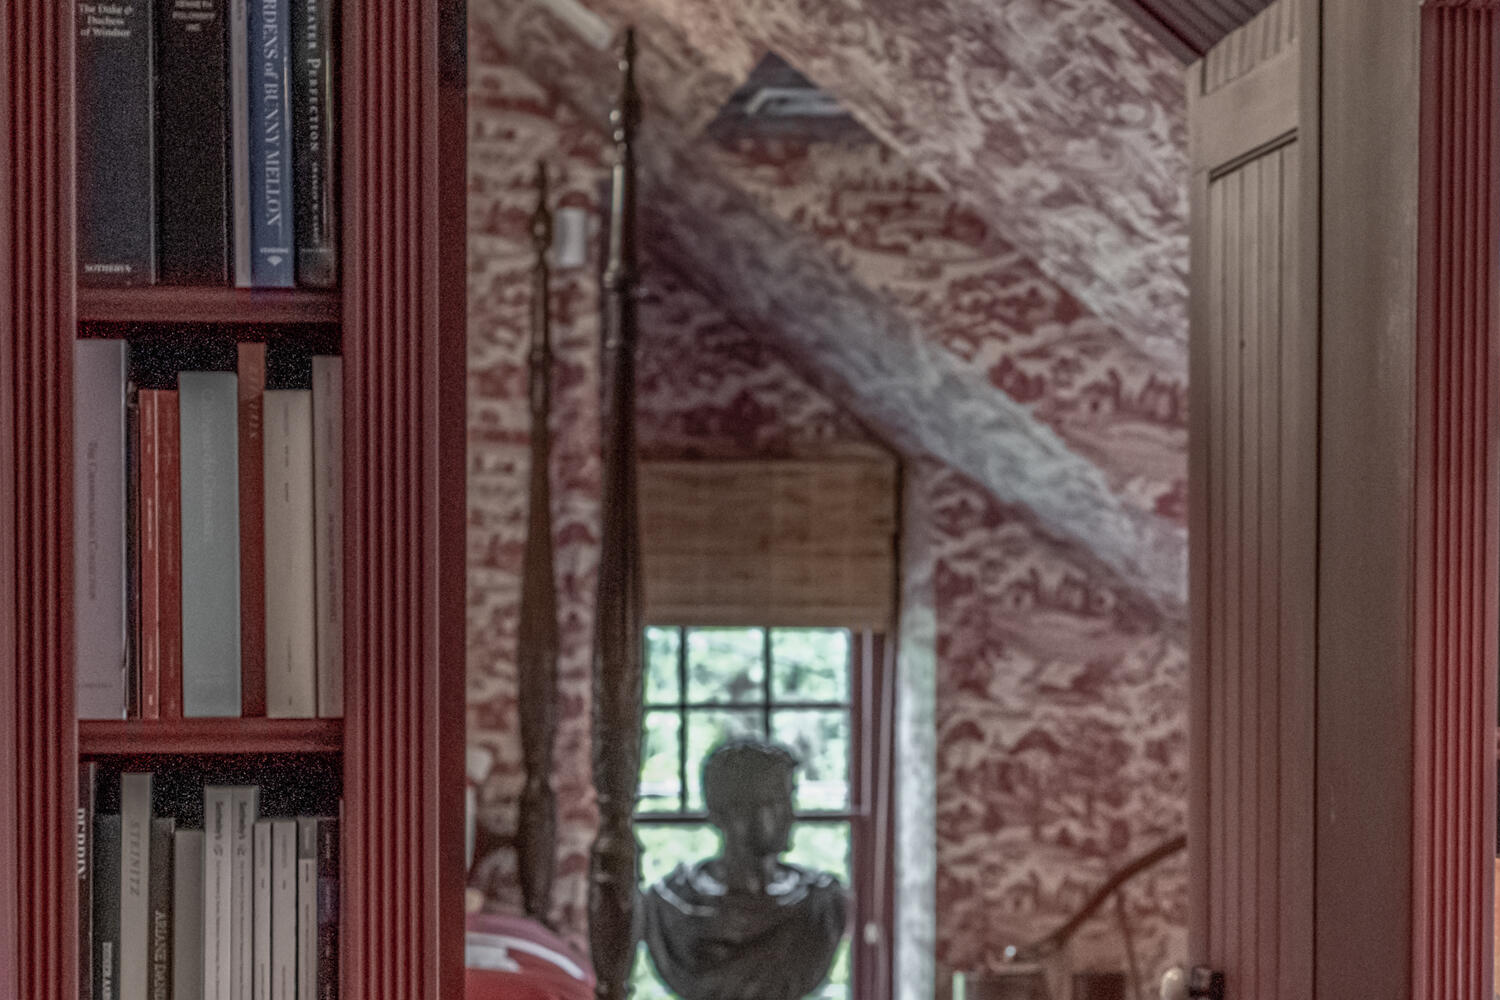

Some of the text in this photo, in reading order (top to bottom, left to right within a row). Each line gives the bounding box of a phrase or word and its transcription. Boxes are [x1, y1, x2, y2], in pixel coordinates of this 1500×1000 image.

[262, 63, 282, 228] of BUNNY MELLON
[129, 820, 141, 897] STEINITZ
